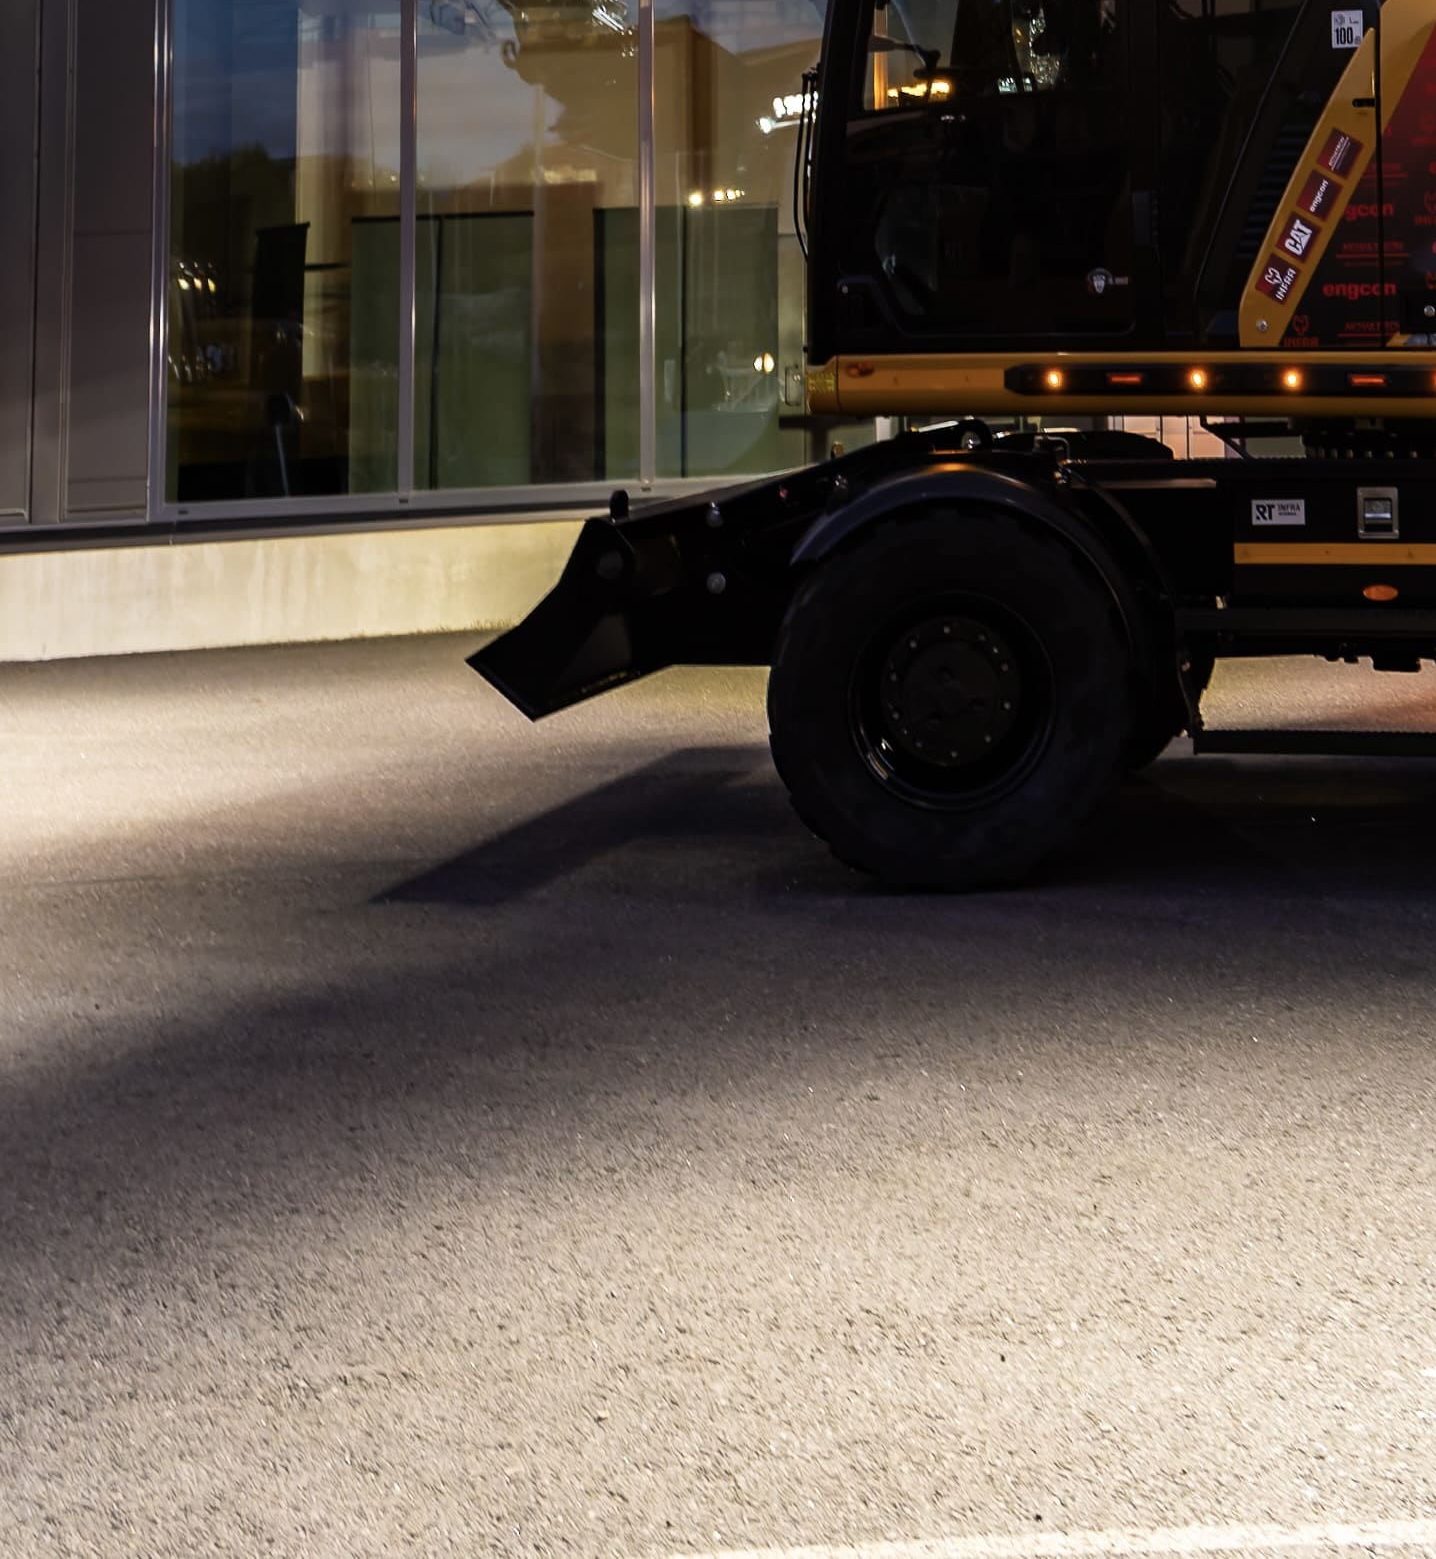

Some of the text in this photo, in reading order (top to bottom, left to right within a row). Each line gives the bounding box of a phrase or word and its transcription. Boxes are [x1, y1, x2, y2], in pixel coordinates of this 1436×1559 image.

[1336, 26, 1353, 45] 100
[1310, 178, 1329, 213] engcon
[1284, 219, 1313, 256] CAT
[1275, 267, 1296, 302] INFRA
